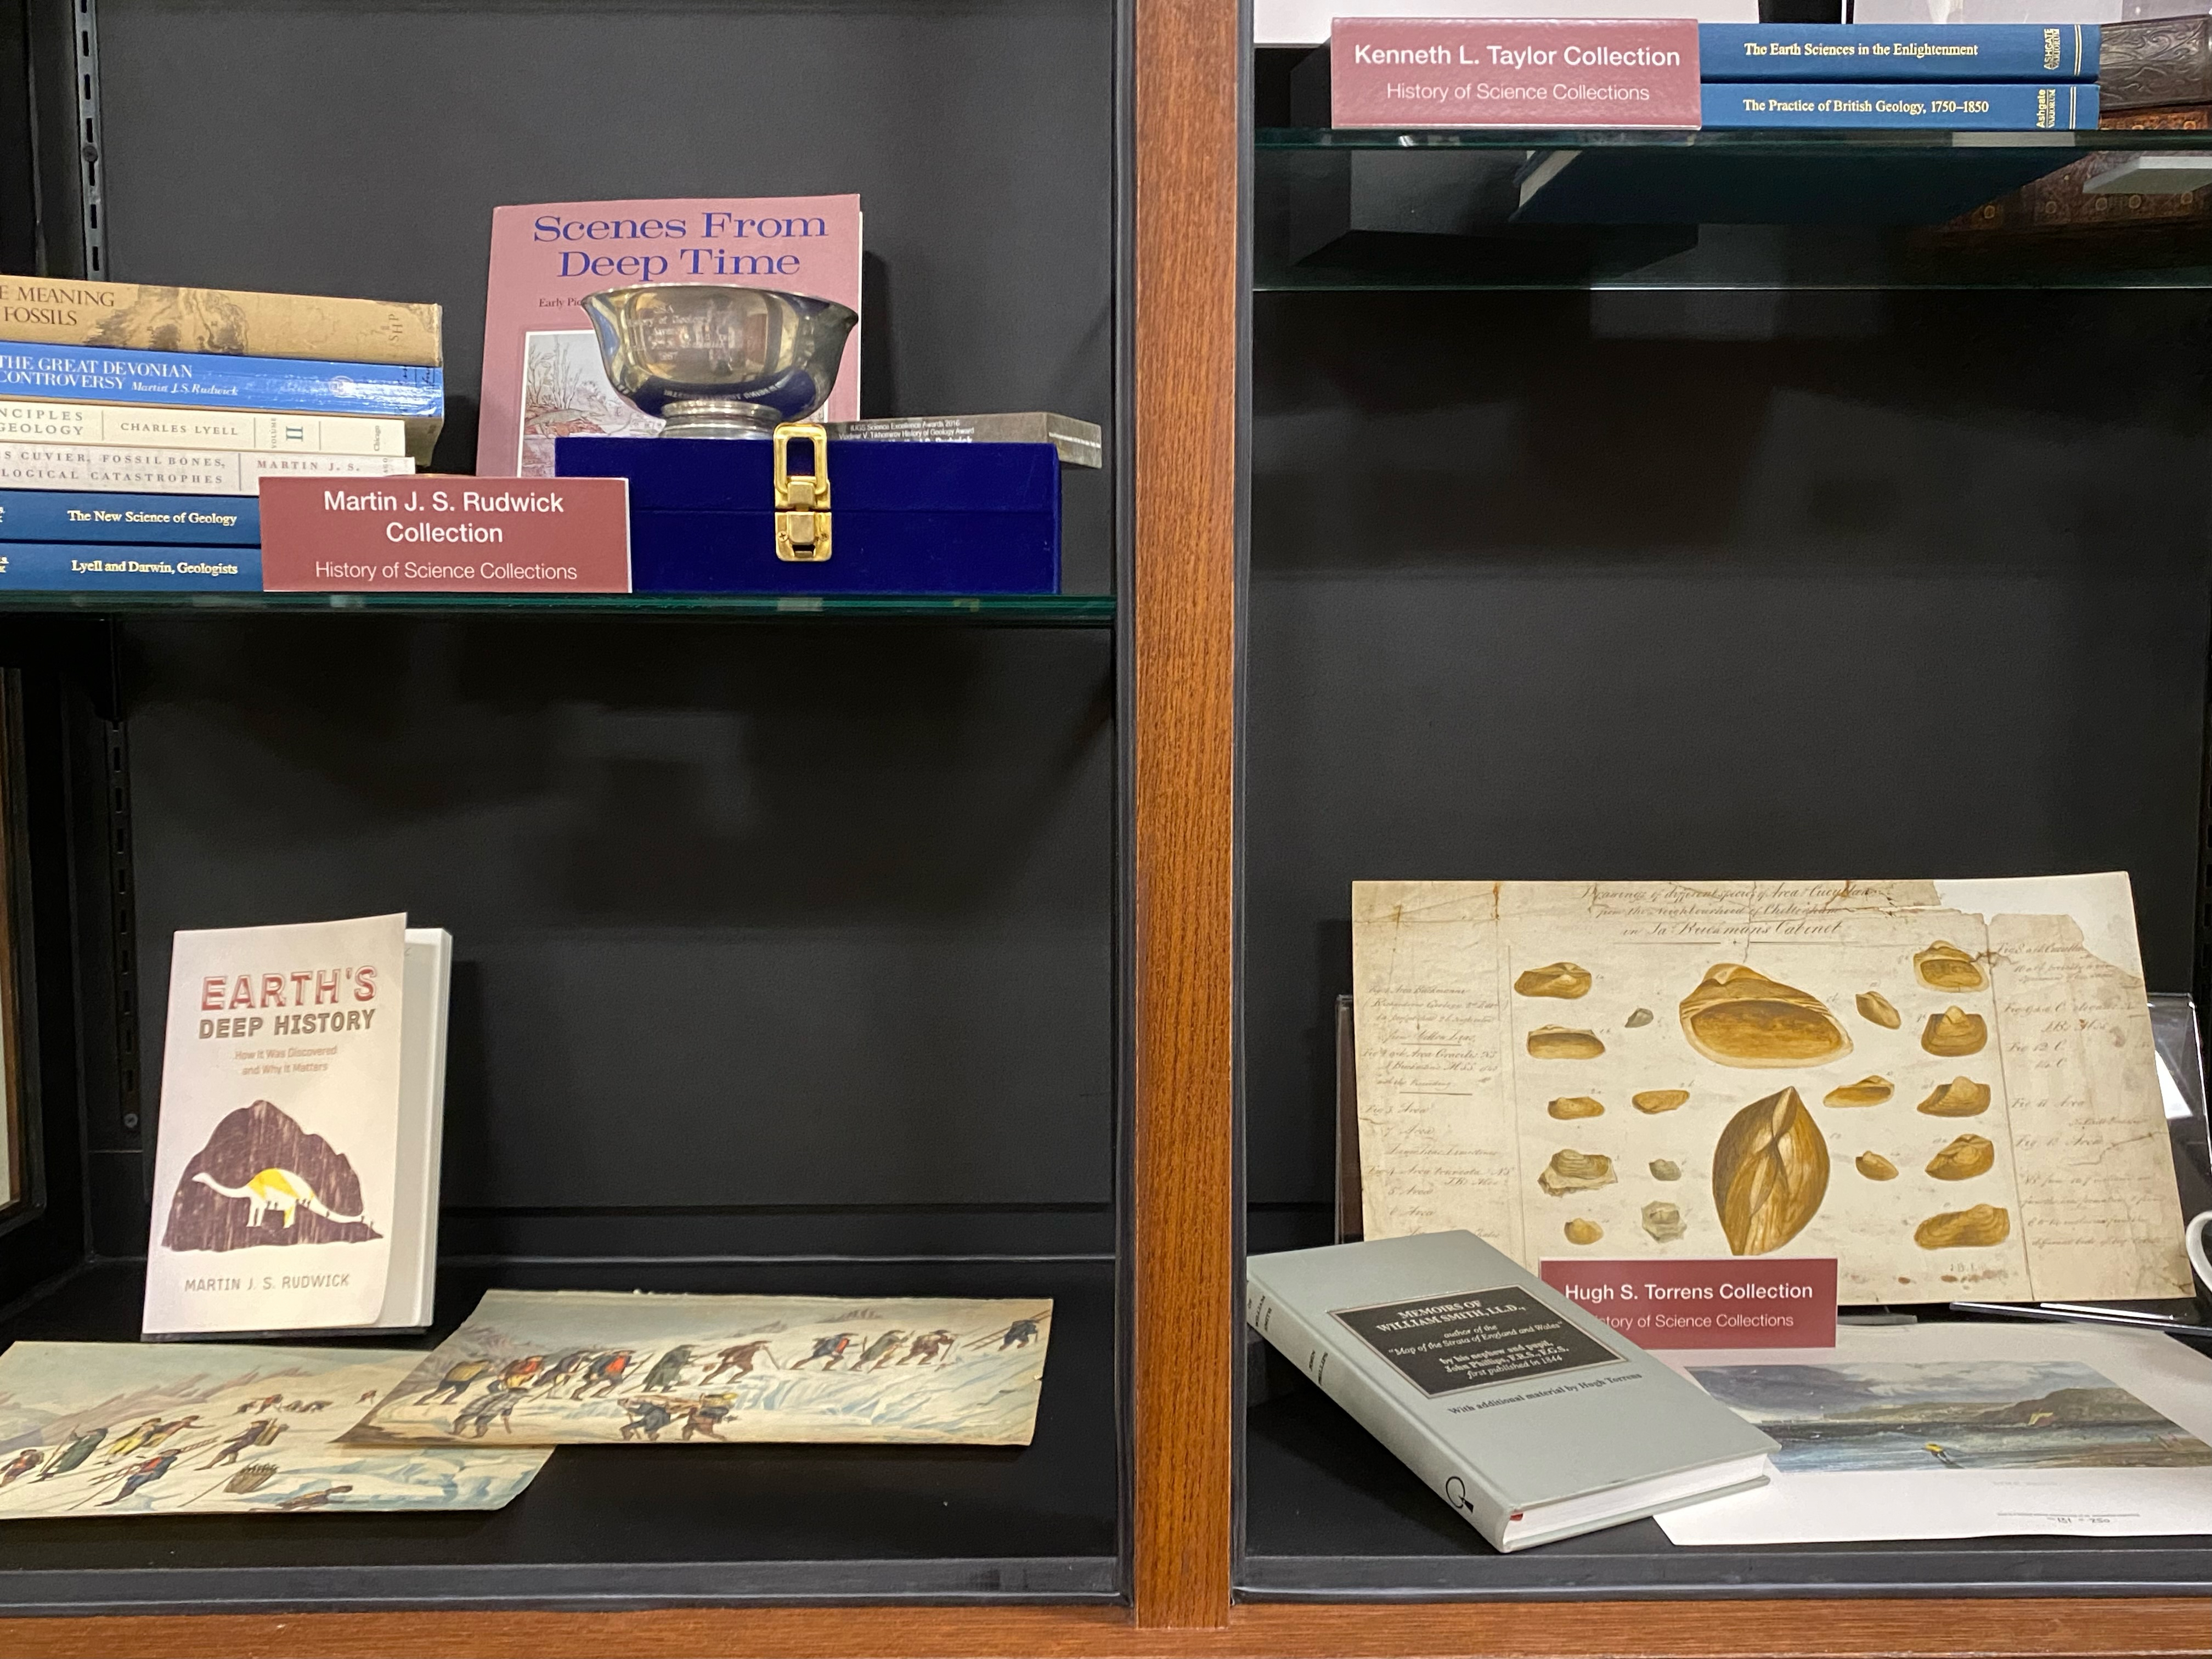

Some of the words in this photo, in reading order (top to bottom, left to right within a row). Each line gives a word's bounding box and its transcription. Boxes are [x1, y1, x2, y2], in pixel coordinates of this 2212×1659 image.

[1355, 44, 1451, 65] Kenneth
[1459, 45, 1480, 65] L.
[1486, 46, 1556, 69] Taylor
[1564, 46, 1680, 67] Collection
[1744, 43, 1767, 55] The
[1769, 43, 1802, 55] Earth
[1804, 43, 1855, 55] Sciences
[1858, 43, 1870, 55] in
[1872, 43, 1891, 55] the
[1893, 43, 1979, 59] Enlightenment
[1386, 83, 1448, 103] History
[1454, 83, 1471, 99] of
[1476, 83, 1547, 100] Science
[1552, 83, 1650, 101] Collections
[1743, 99, 1767, 111] The
[1768, 99, 1815, 111] Practice
[1818, 99, 1832, 111] of
[1833, 100, 1872, 112] British
[1875, 101, 1927, 115] Geology,
[2036, 89, 2046, 128] Ashgate
[534, 215, 687, 242] Scenes
[701, 212, 829, 239] From
[557, 250, 668, 282] Deep
[680, 248, 800, 275] Time
[17, 286, 115, 307] MEANING
[539, 298, 565, 308] Early
[4, 306, 77, 326] FOSSILS
[0, 356, 33, 370] THE
[38, 357, 99, 374] GREAT
[103, 360, 193, 379] DEVONIAN
[0, 371, 126, 390] CONTROVERSY
[132, 381, 168, 393] Martin
[191, 383, 239, 396] Rudwick
[121, 422, 187, 433] CHARLES
[195, 426, 239, 436] LYELL
[285, 426, 303, 442] II
[374, 425, 382, 452] Chicago
[902, 430, 922, 438] History
[930, 428, 954, 437] Geology
[103, 455, 161, 465] FOSSIL
[168, 457, 225, 468] BONES,
[257, 460, 318, 470] MARTIN
[329, 462, 341, 471] J.
[91, 471, 223, 483] CATASTROPHES
[324, 491, 397, 511] Martin
[404, 492, 424, 512] J.
[432, 492, 455, 512] S.
[463, 492, 563, 512] Rudwick
[67, 510, 91, 522] The
[93, 511, 122, 522] New
[125, 511, 170, 523] Science
[173, 512, 186, 523] of
[188, 512, 237, 527] Geology
[386, 522, 503, 543] Collection
[71, 560, 103, 574] Lyell
[105, 562, 126, 572] and
[129, 561, 176, 575] Darwin,
[177, 562, 238, 577] Geologists
[315, 561, 377, 582] History
[382, 561, 399, 579] of
[404, 561, 475, 579] Science
[479, 562, 577, 580] Collections
[1775, 921, 1842, 935] Cabinet
[201, 965, 379, 1012] EARTH'S
[199, 1017, 264, 1040] DEEP
[274, 1009, 376, 1036] HISTORY
[235, 1051, 256, 1059] How
[266, 1049, 286, 1058] Was
[287, 1045, 337, 1058] Discovered
[242, 1066, 259, 1075] and
[262, 1065, 281, 1074] Why
[293, 1063, 328, 1073] Matters
[184, 1277, 240, 1292] MARTIN
[281, 1273, 350, 1289] RUDWICK
[1565, 1284, 1613, 1304] Hugh
[1620, 1284, 1638, 1300] S.
[1644, 1284, 1713, 1300] Torrens
[1719, 1283, 1813, 1300] Collection
[1398, 1302, 1464, 1319] MEMOIRS
[1463, 1300, 1481, 1309] OF
[1376, 1316, 1442, 1332] WILLIAM
[1440, 1309, 1490, 1322] SMITH,
[1637, 1314, 1650, 1327] of
[1655, 1314, 1712, 1328] Science
[1716, 1314, 1794, 1327] Collections
[1417, 1342, 1427, 1353] of
[1427, 1341, 1442, 1350] the
[1442, 1336, 1471, 1348] Strata
[1471, 1334, 1481, 1343] of
[1481, 1328, 1517, 1340] England
[1519, 1325, 1535, 1334] and
[1444, 1329, 1471, 1339] author
[1474, 1325, 1483, 1335] of
[1453, 1353, 1470, 1362] his
[1470, 1348, 1505, 1360] nephew
[1506, 1344, 1526, 1354] and
[1445, 1362, 1471, 1373] John
[1466, 1369, 1487, 1380] first
[1487, 1361, 1530, 1375] published
[1448, 1403, 1475, 1414] With
[1476, 1395, 1525, 1409] additional
[1526, 1386, 1565, 1400] material
[1565, 1384, 1579, 1392] by
[1579, 1379, 1606, 1389] Hugh
[1605, 1373, 1643, 1384] Torrens
